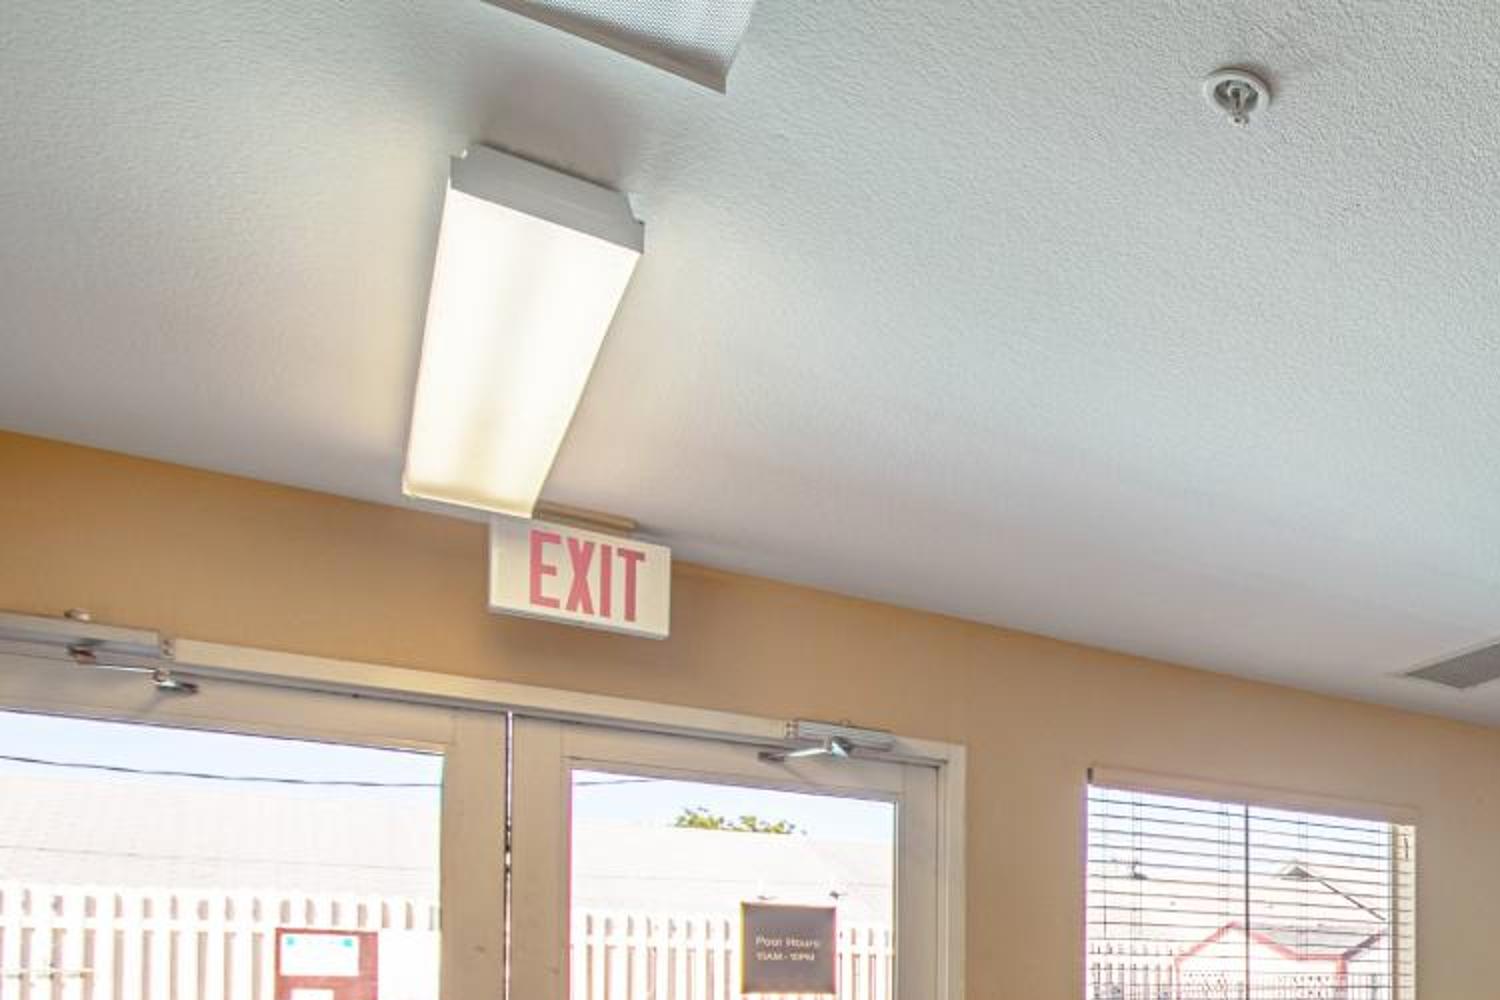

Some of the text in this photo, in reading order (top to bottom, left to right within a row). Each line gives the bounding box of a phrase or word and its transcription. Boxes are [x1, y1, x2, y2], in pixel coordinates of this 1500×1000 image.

[529, 530, 646, 622] EXIT
[755, 936, 820, 949] Pool Hours
